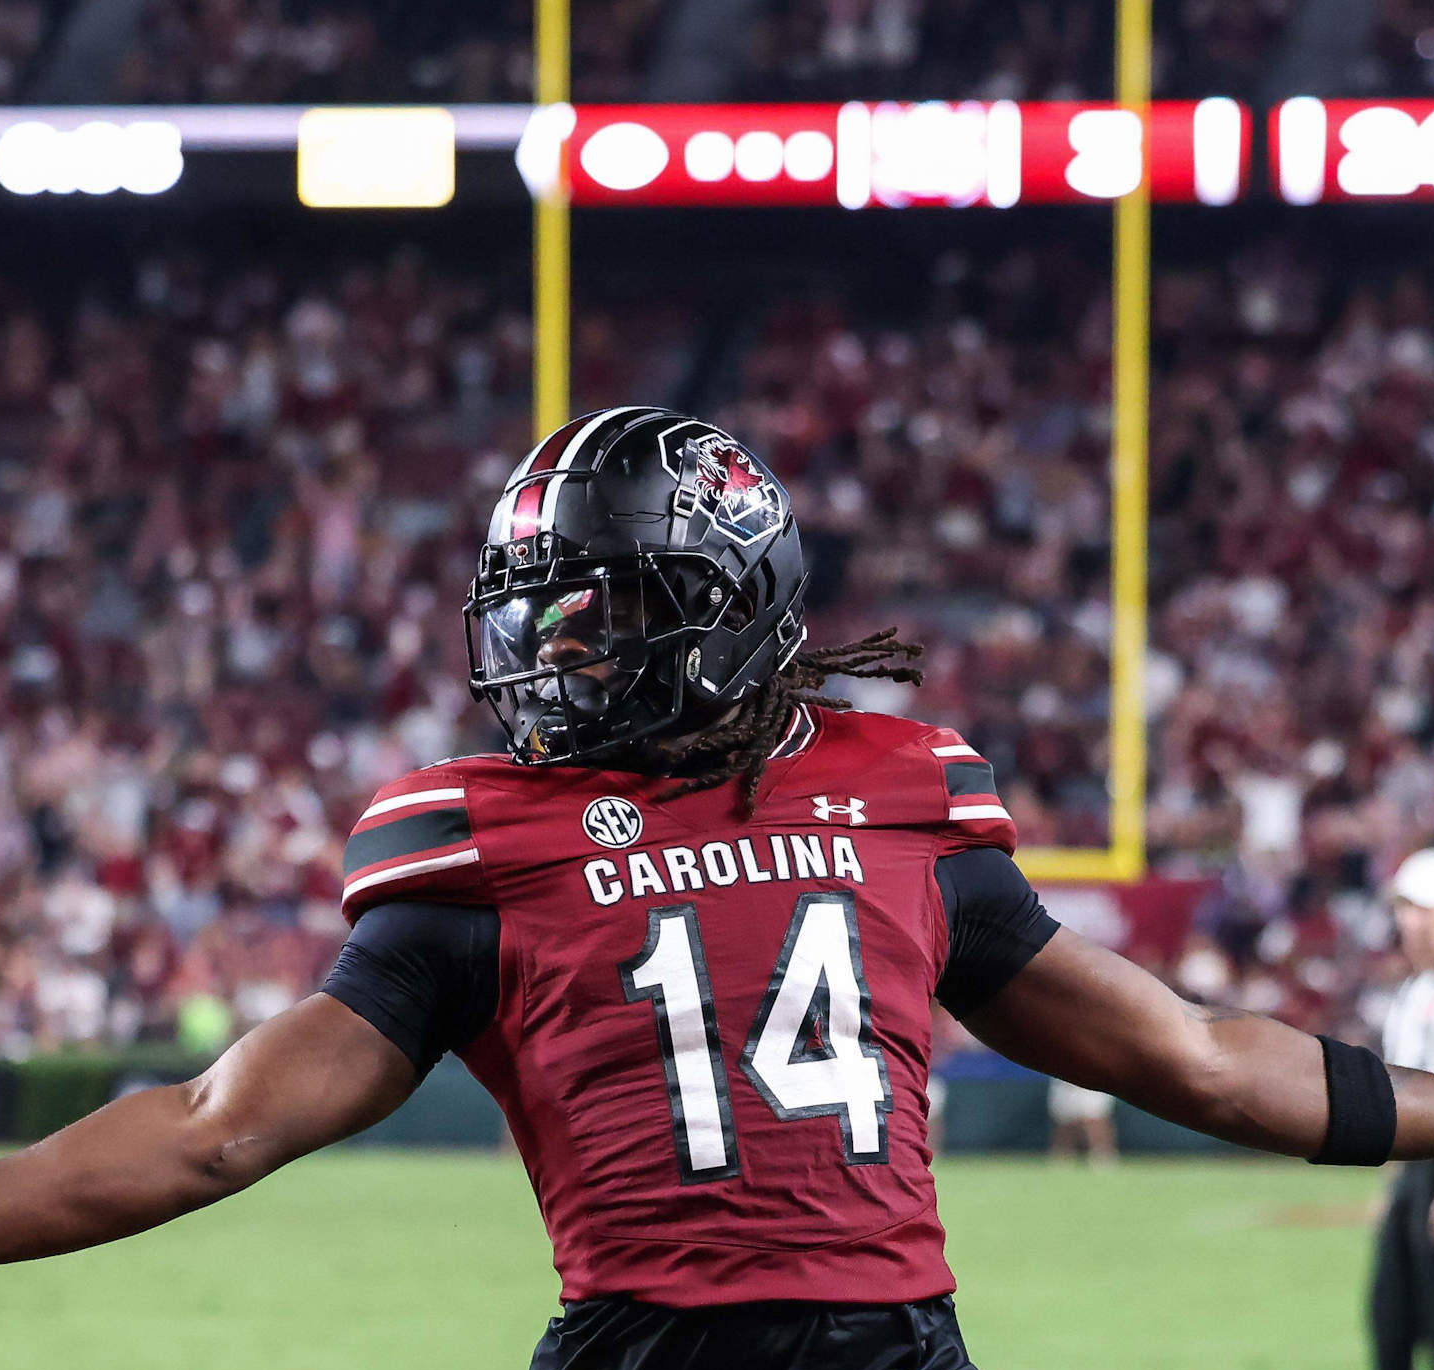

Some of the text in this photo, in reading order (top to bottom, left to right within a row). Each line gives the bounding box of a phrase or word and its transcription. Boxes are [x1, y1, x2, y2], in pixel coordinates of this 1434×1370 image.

[588, 800, 639, 845] SEC
[582, 832, 865, 907] CAROLINA
[618, 891, 892, 1186] 14
